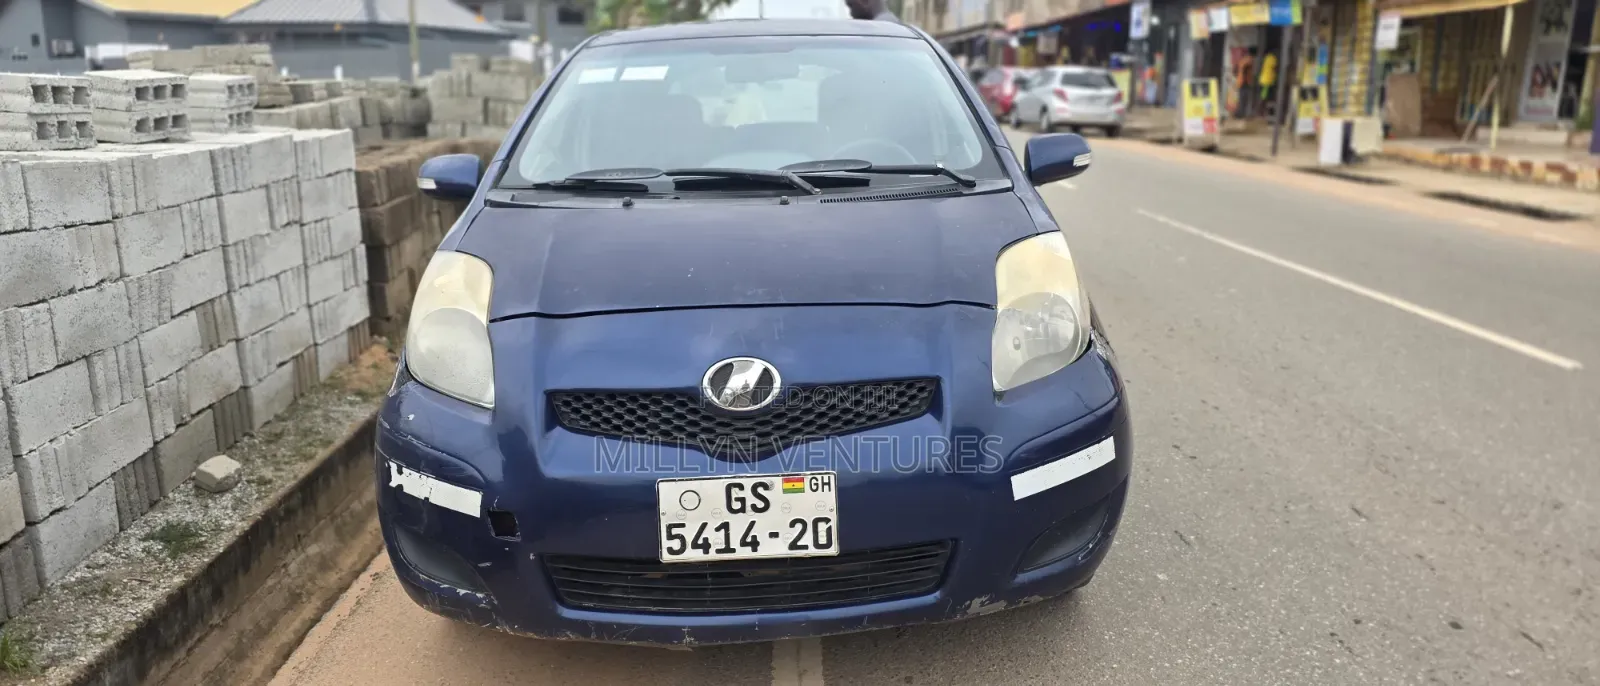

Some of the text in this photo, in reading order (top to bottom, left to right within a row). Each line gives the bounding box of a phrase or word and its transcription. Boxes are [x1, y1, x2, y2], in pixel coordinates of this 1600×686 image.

[725, 481, 771, 514] GS
[809, 476, 832, 493] GH
[665, 516, 833, 556] 5414-20
